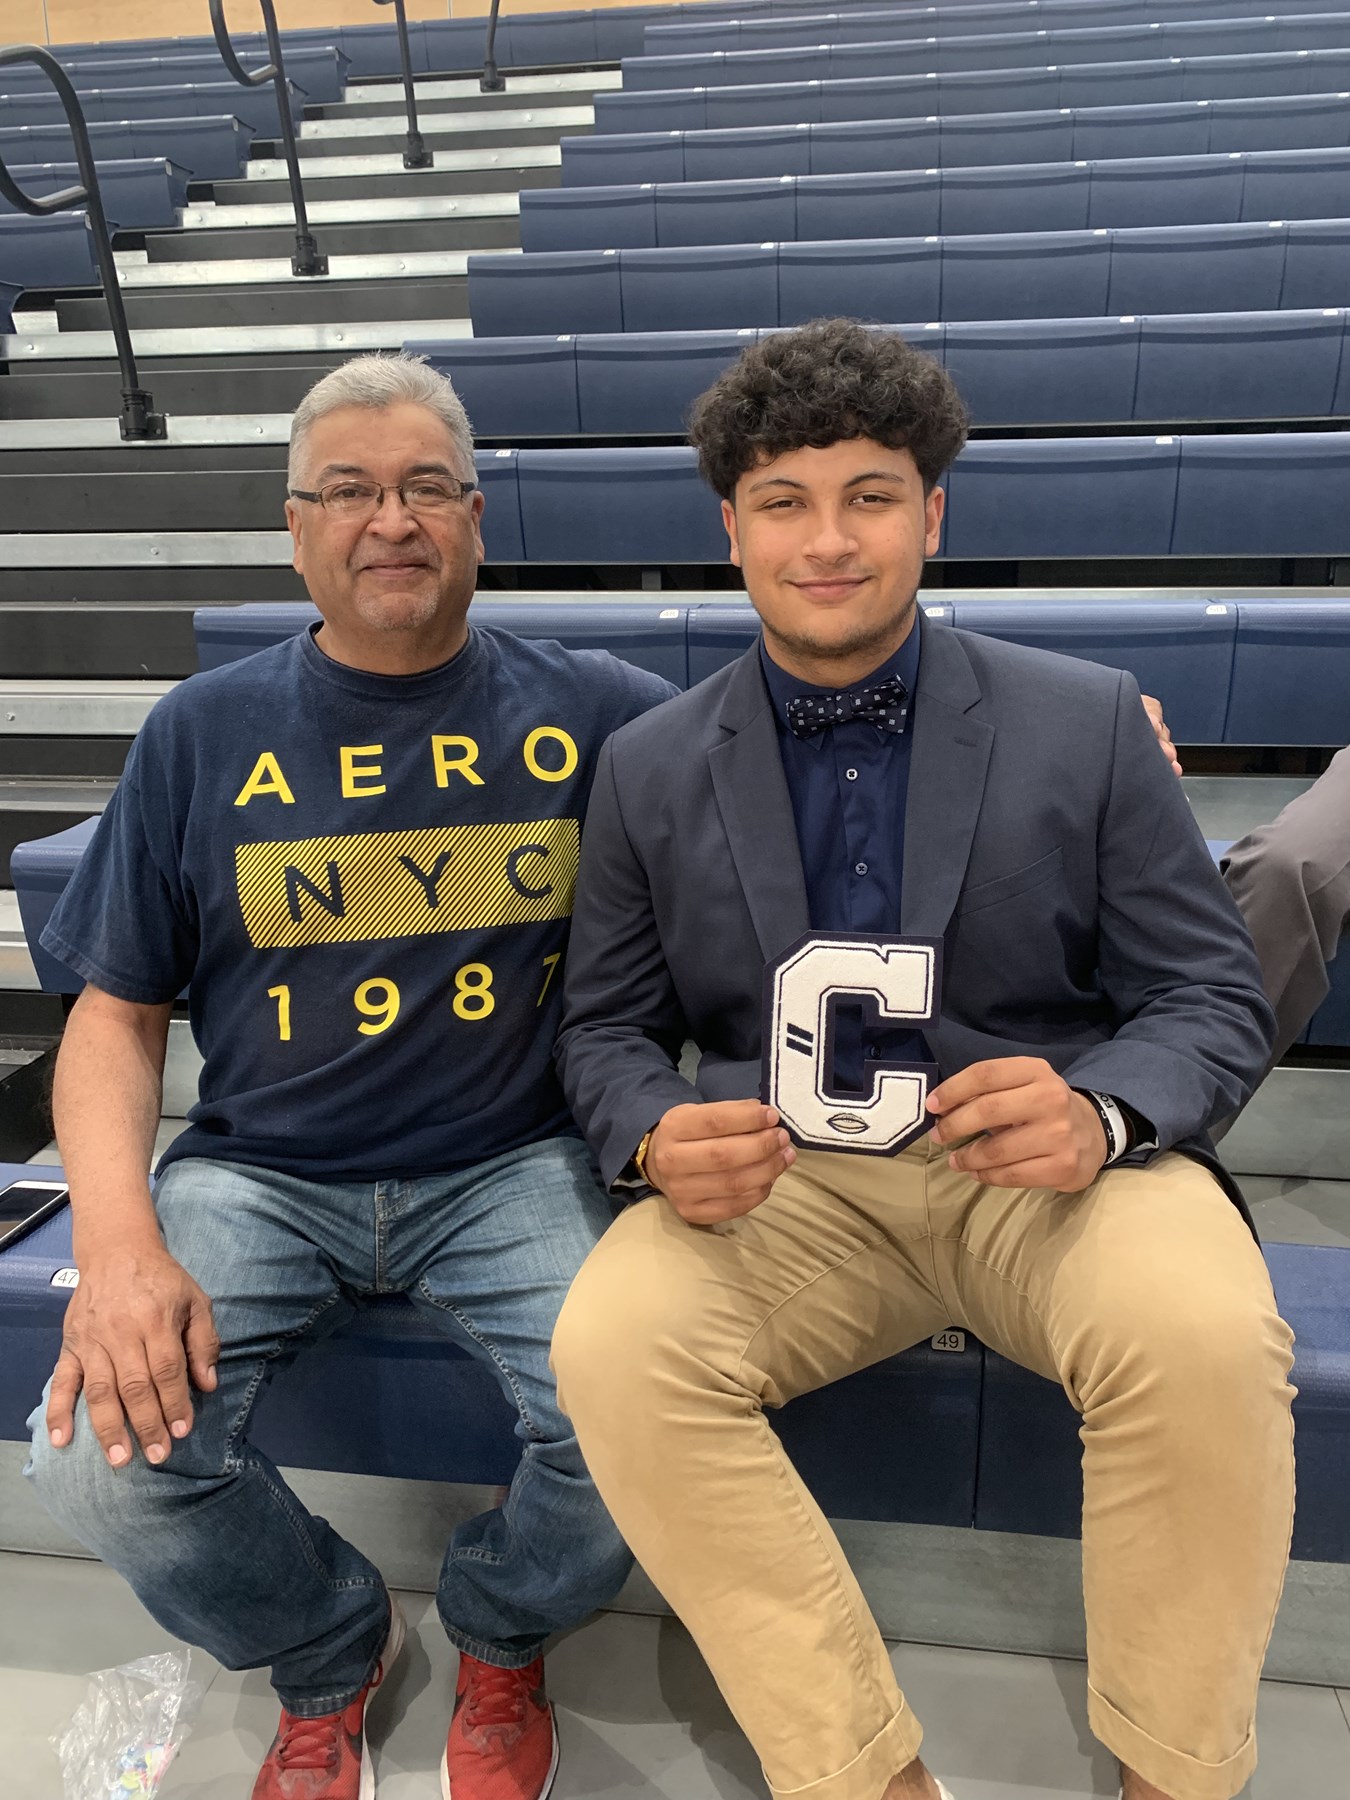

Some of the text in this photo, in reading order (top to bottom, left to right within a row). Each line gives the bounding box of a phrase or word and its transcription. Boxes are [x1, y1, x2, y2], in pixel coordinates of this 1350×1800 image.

[234, 726, 579, 806] AERO
[284, 843, 554, 924] NYC
[267, 953, 561, 1041] 1987
[769, 939, 936, 1151] C
[1100, 1094, 1114, 1108] FO
[58, 1271, 78, 1284] 47
[937, 1334, 959, 1348] 49
